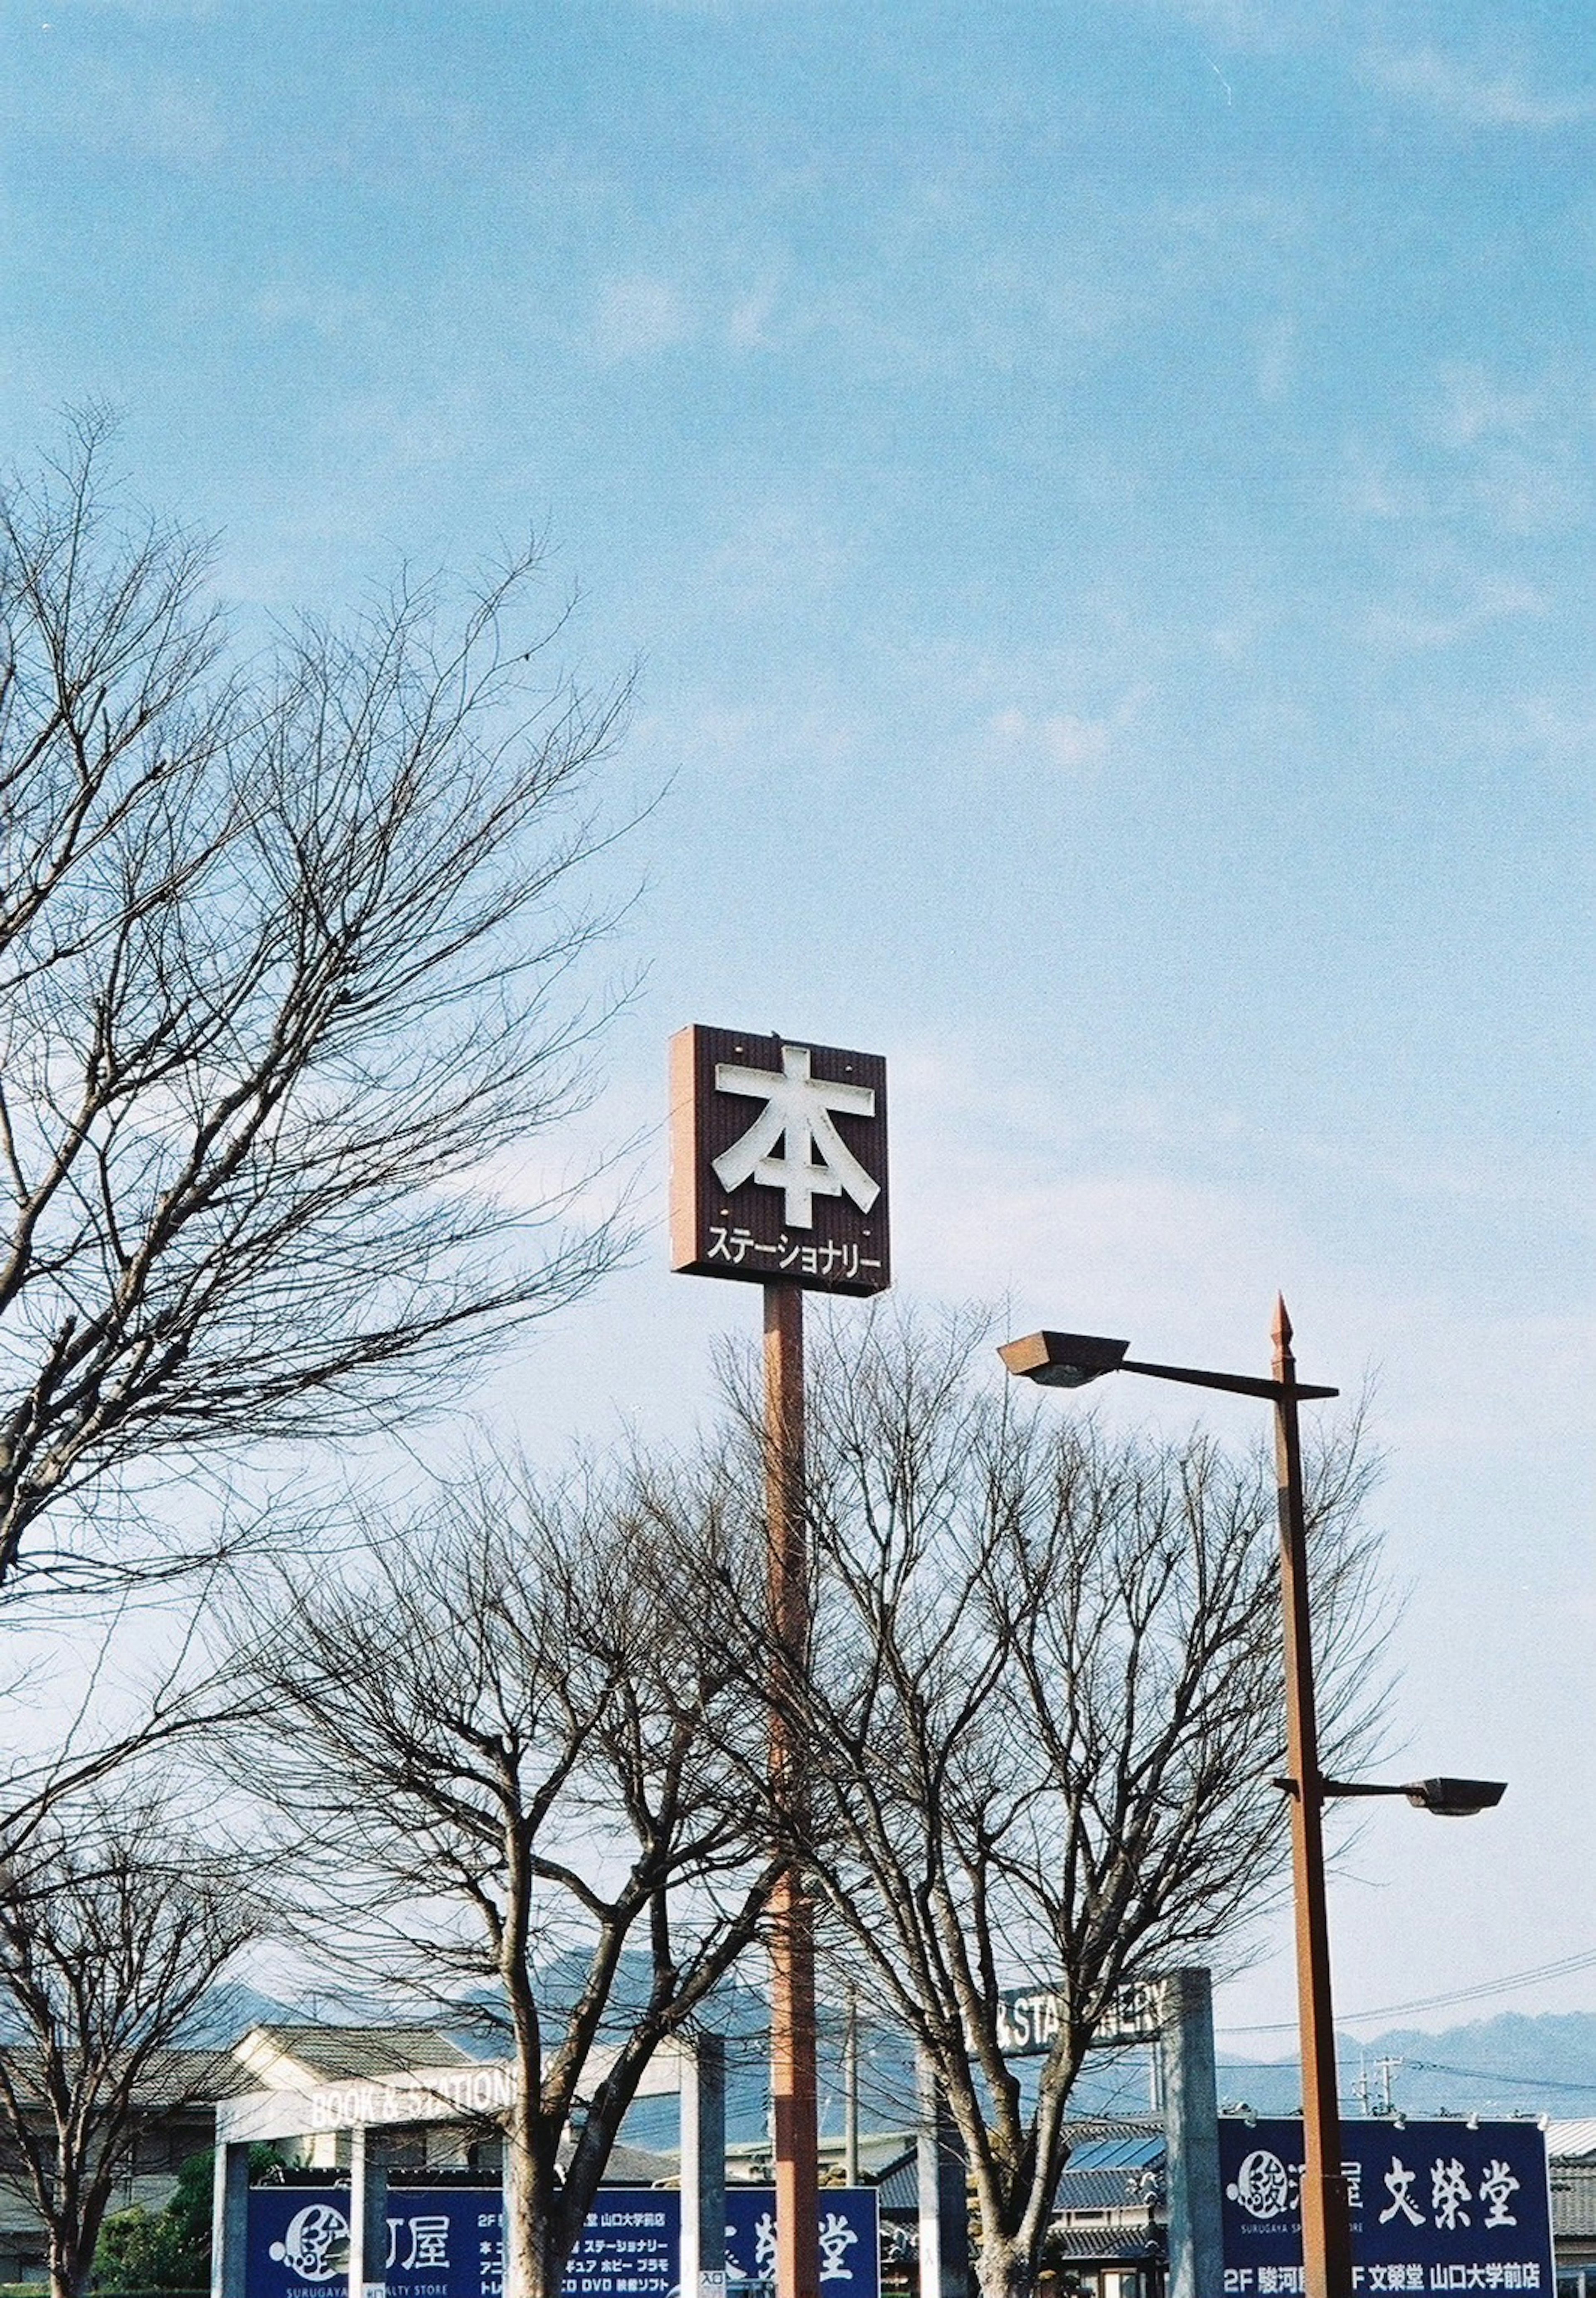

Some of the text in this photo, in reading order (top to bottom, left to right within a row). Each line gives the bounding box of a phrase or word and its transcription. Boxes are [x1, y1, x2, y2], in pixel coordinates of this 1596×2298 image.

[712, 1044, 881, 1229] 本
[707, 1227, 881, 1278] ステーショナリー
[311, 2086, 375, 2128] BOOK
[409, 2066, 518, 2120] STATION
[478, 2214, 495, 2227] 2F
[601, 2212, 665, 2227] 山口大学前店
[480, 2241, 492, 2254] 本
[584, 2239, 668, 2253] ステーショナリー
[480, 2261, 503, 2275] アニ
[601, 2259, 633, 2272] ホビー
[1224, 2268, 1253, 2292] 2F
[1351, 2266, 1365, 2290] F
[1430, 2261, 1540, 2290] 山口大学前店
[286, 2286, 347, 2298] SURUGAYA
[415, 2284, 448, 2295] STORE
[582, 2278, 612, 2292] DVD
